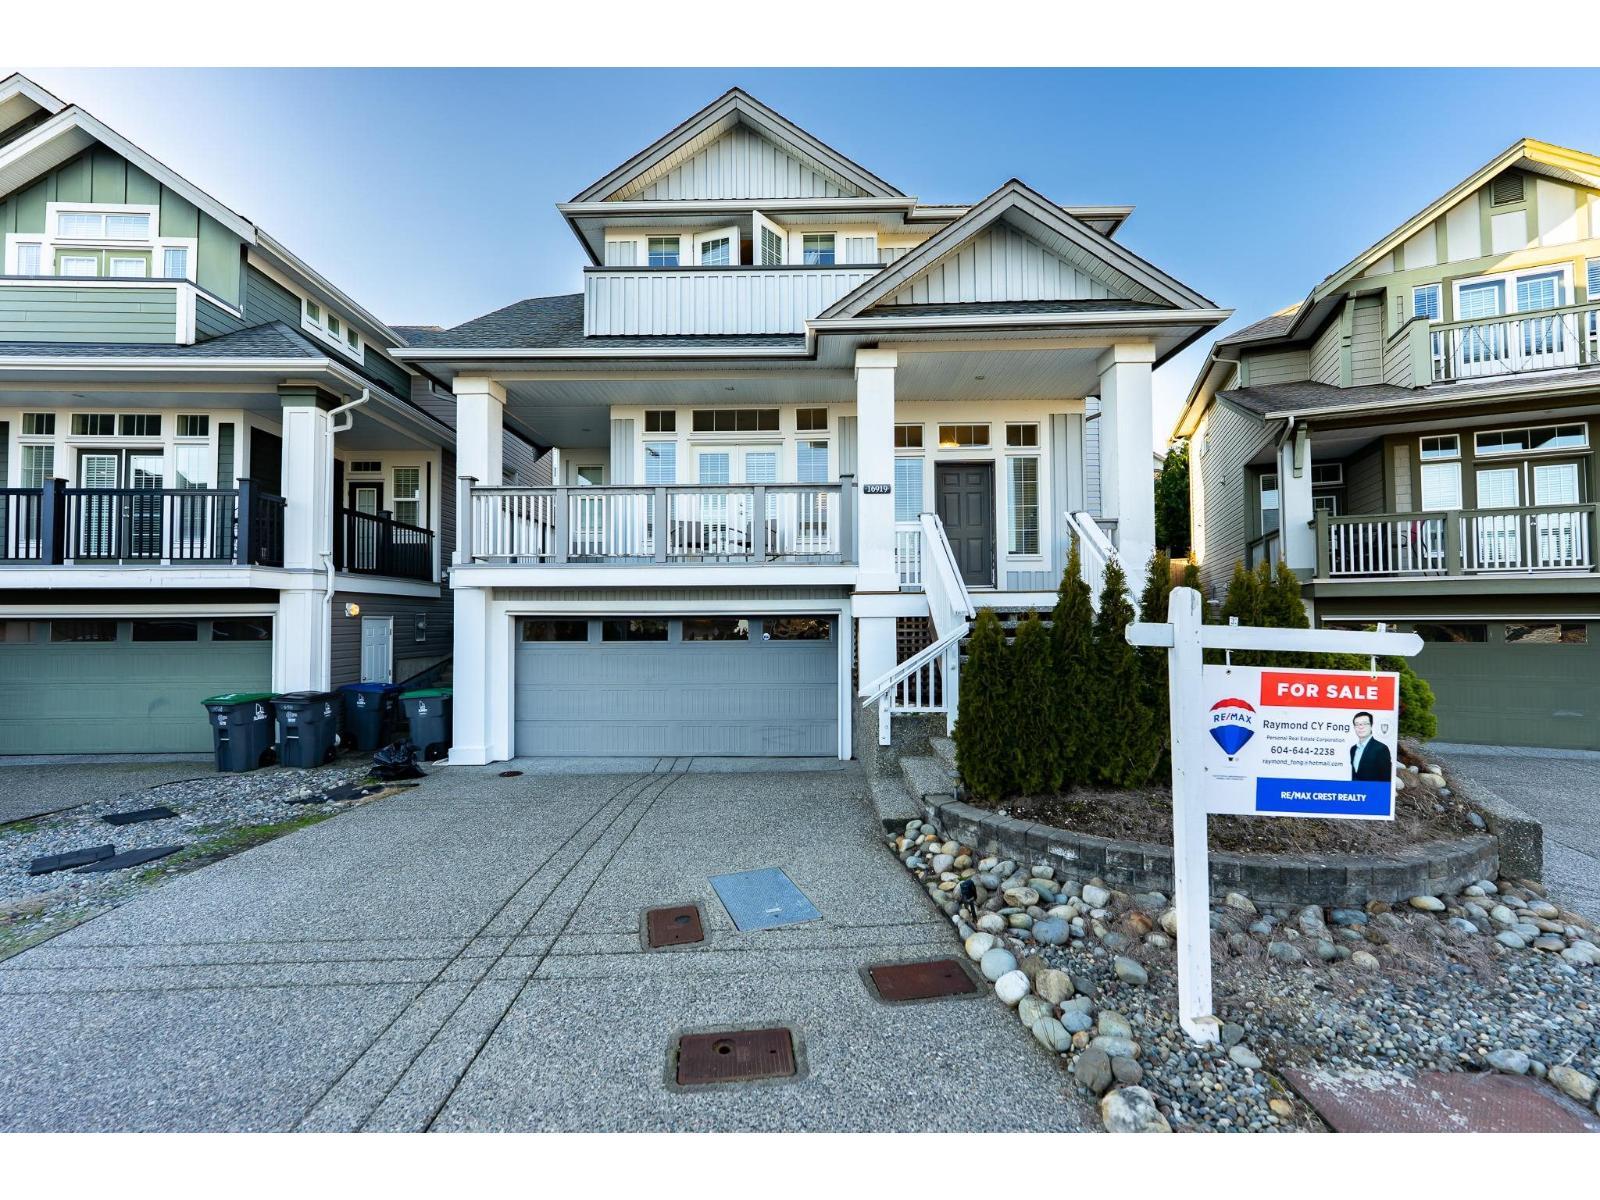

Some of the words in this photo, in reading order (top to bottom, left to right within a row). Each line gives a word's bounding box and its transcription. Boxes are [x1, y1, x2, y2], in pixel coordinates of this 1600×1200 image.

[1277, 682, 1319, 698] FOR
[1326, 684, 1378, 700] SALE
[1213, 712, 1252, 724] RE/MAX
[1263, 720, 1308, 730] Raymond
[1311, 721, 1324, 730] CY
[1326, 722, 1350, 733] Fong
[1270, 745, 1335, 756] 604-644-2238
[1280, 791, 1312, 801] RE/MAX
[1312, 792, 1337, 801] CREST
[1337, 793, 1367, 802] REALTY
